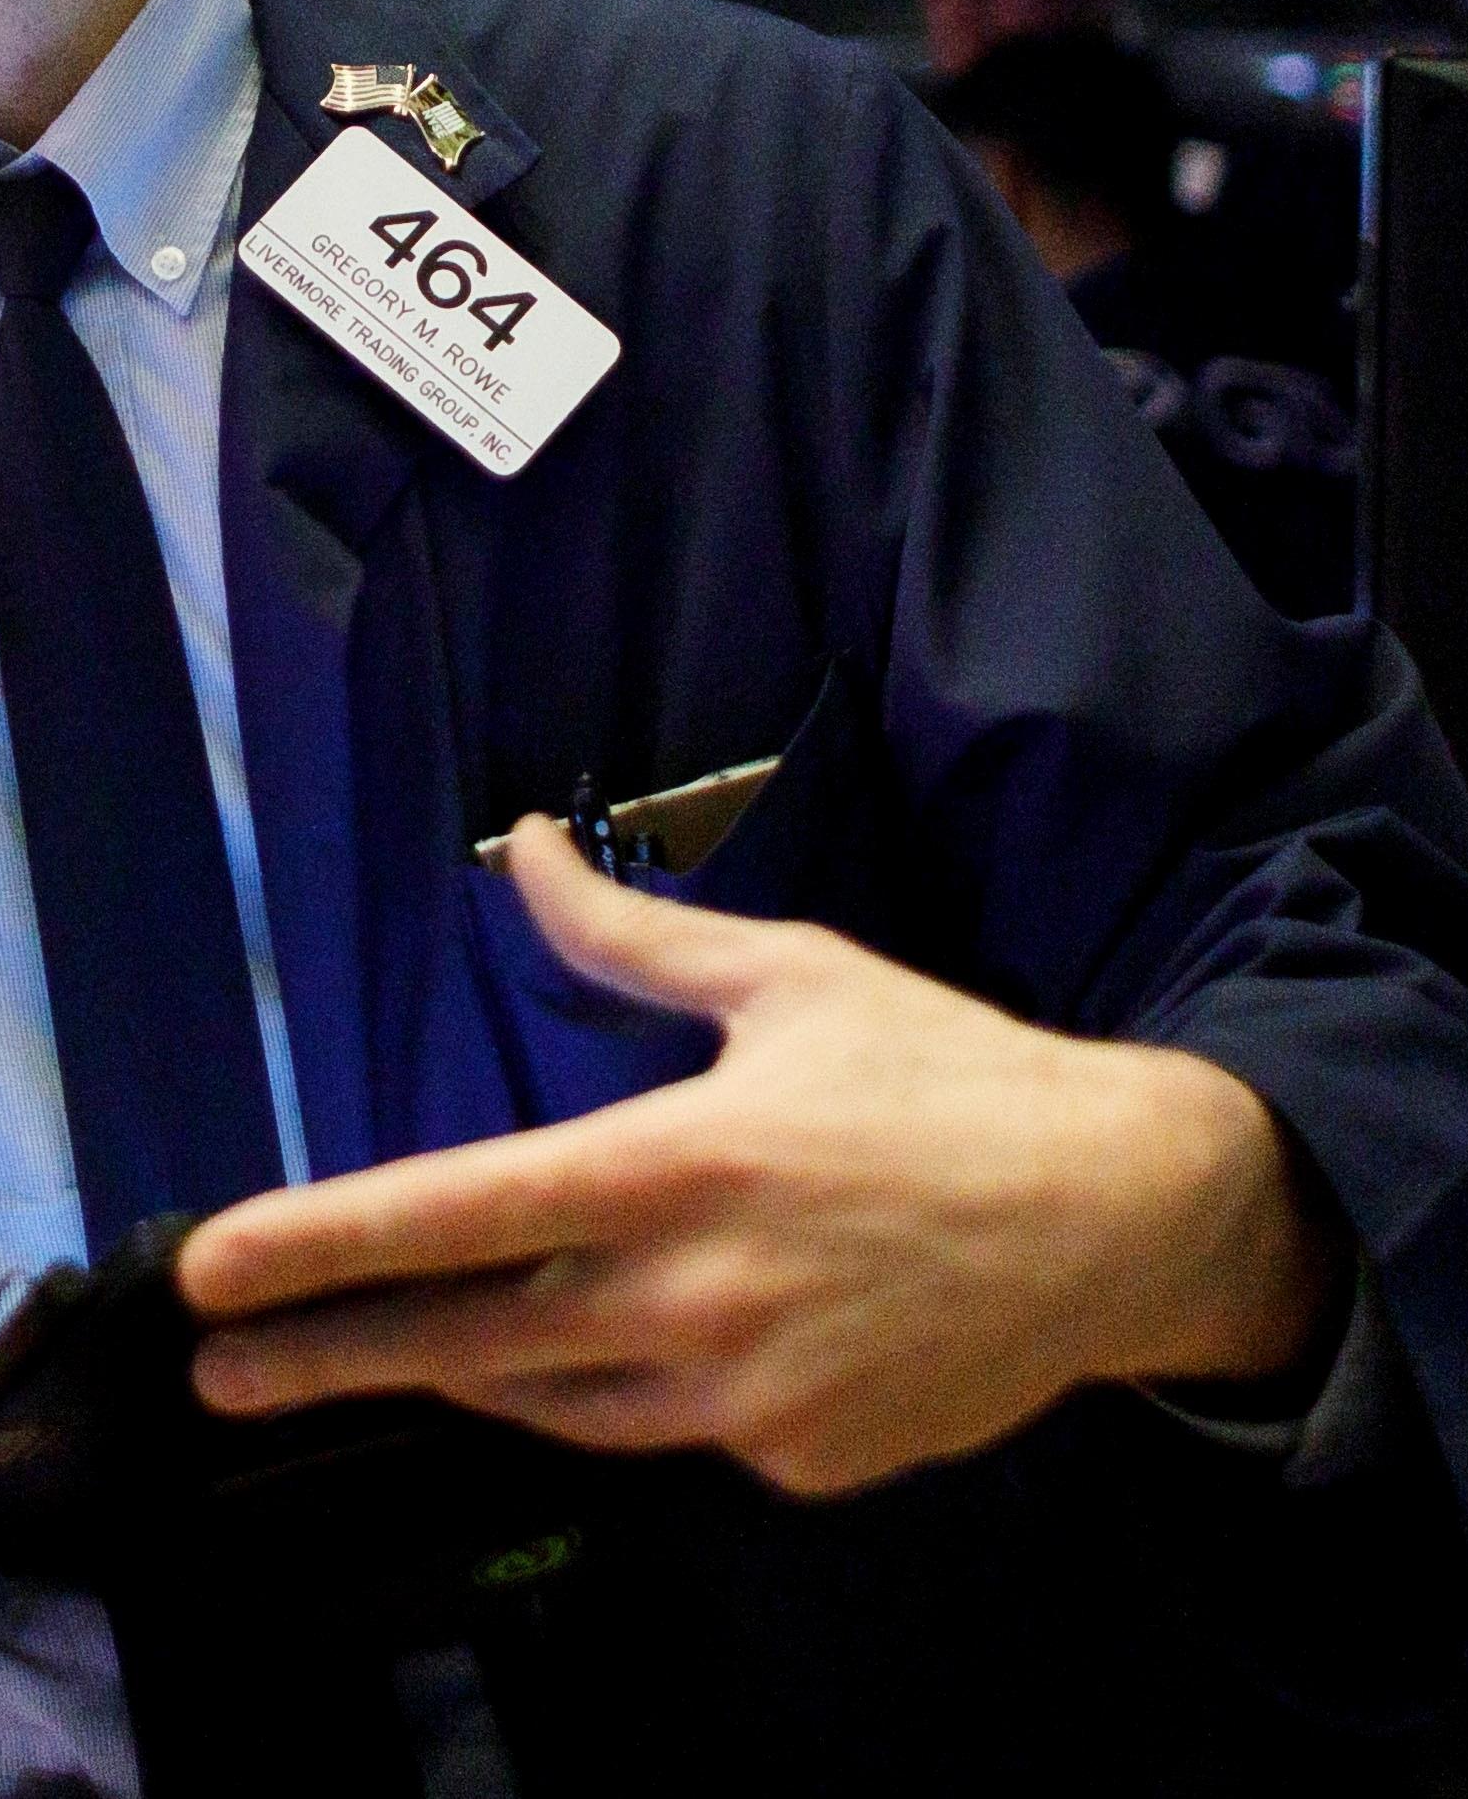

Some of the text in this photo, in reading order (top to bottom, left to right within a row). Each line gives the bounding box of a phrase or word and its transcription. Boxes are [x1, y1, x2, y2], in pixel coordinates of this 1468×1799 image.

[245, 234, 511, 466] LIVERMORE TRADING GROUP, INC.
[312, 233, 512, 405] GREGORY M. ROWE
[368, 209, 539, 353] 464
